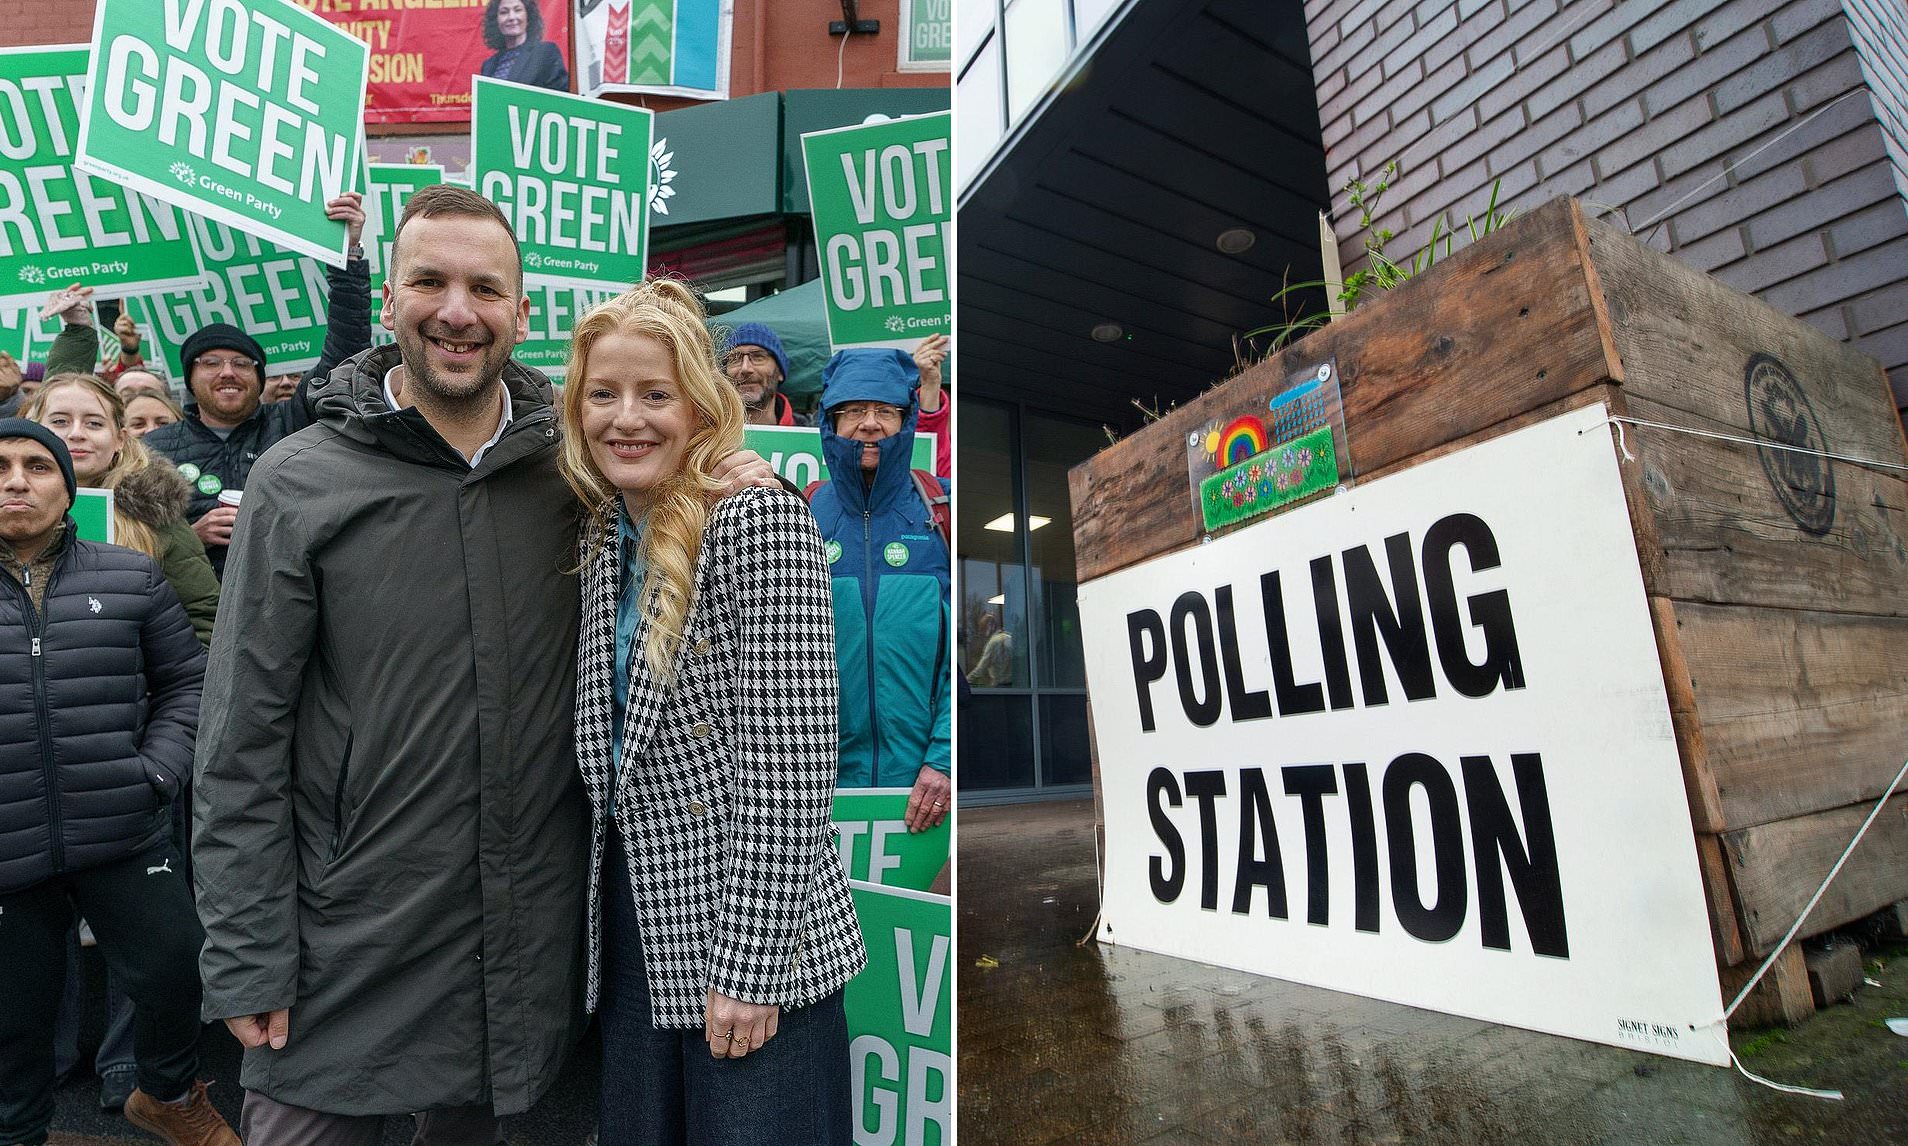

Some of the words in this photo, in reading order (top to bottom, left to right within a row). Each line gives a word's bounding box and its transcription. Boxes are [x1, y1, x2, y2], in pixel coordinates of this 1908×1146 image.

[163, 0, 327, 117] VOTE
[104, 34, 347, 214] GREEN
[508, 104, 622, 184] VOTE
[200, 175, 243, 203] Green
[247, 193, 283, 221] Party
[482, 170, 641, 256] GREEN
[46, 266, 89, 280] Green
[93, 261, 129, 276] Party
[543, 256, 572, 269] Green
[575, 261, 599, 274] Party
[826, 220, 951, 311] GRE
[281, 340, 311, 353] Party
[907, 316, 942, 329] Green
[517, 350, 543, 359] Green
[1126, 513, 1527, 734] POLLING
[1146, 752, 1570, 961] STATION
[1652, 1023, 1679, 1040] SIGNS
